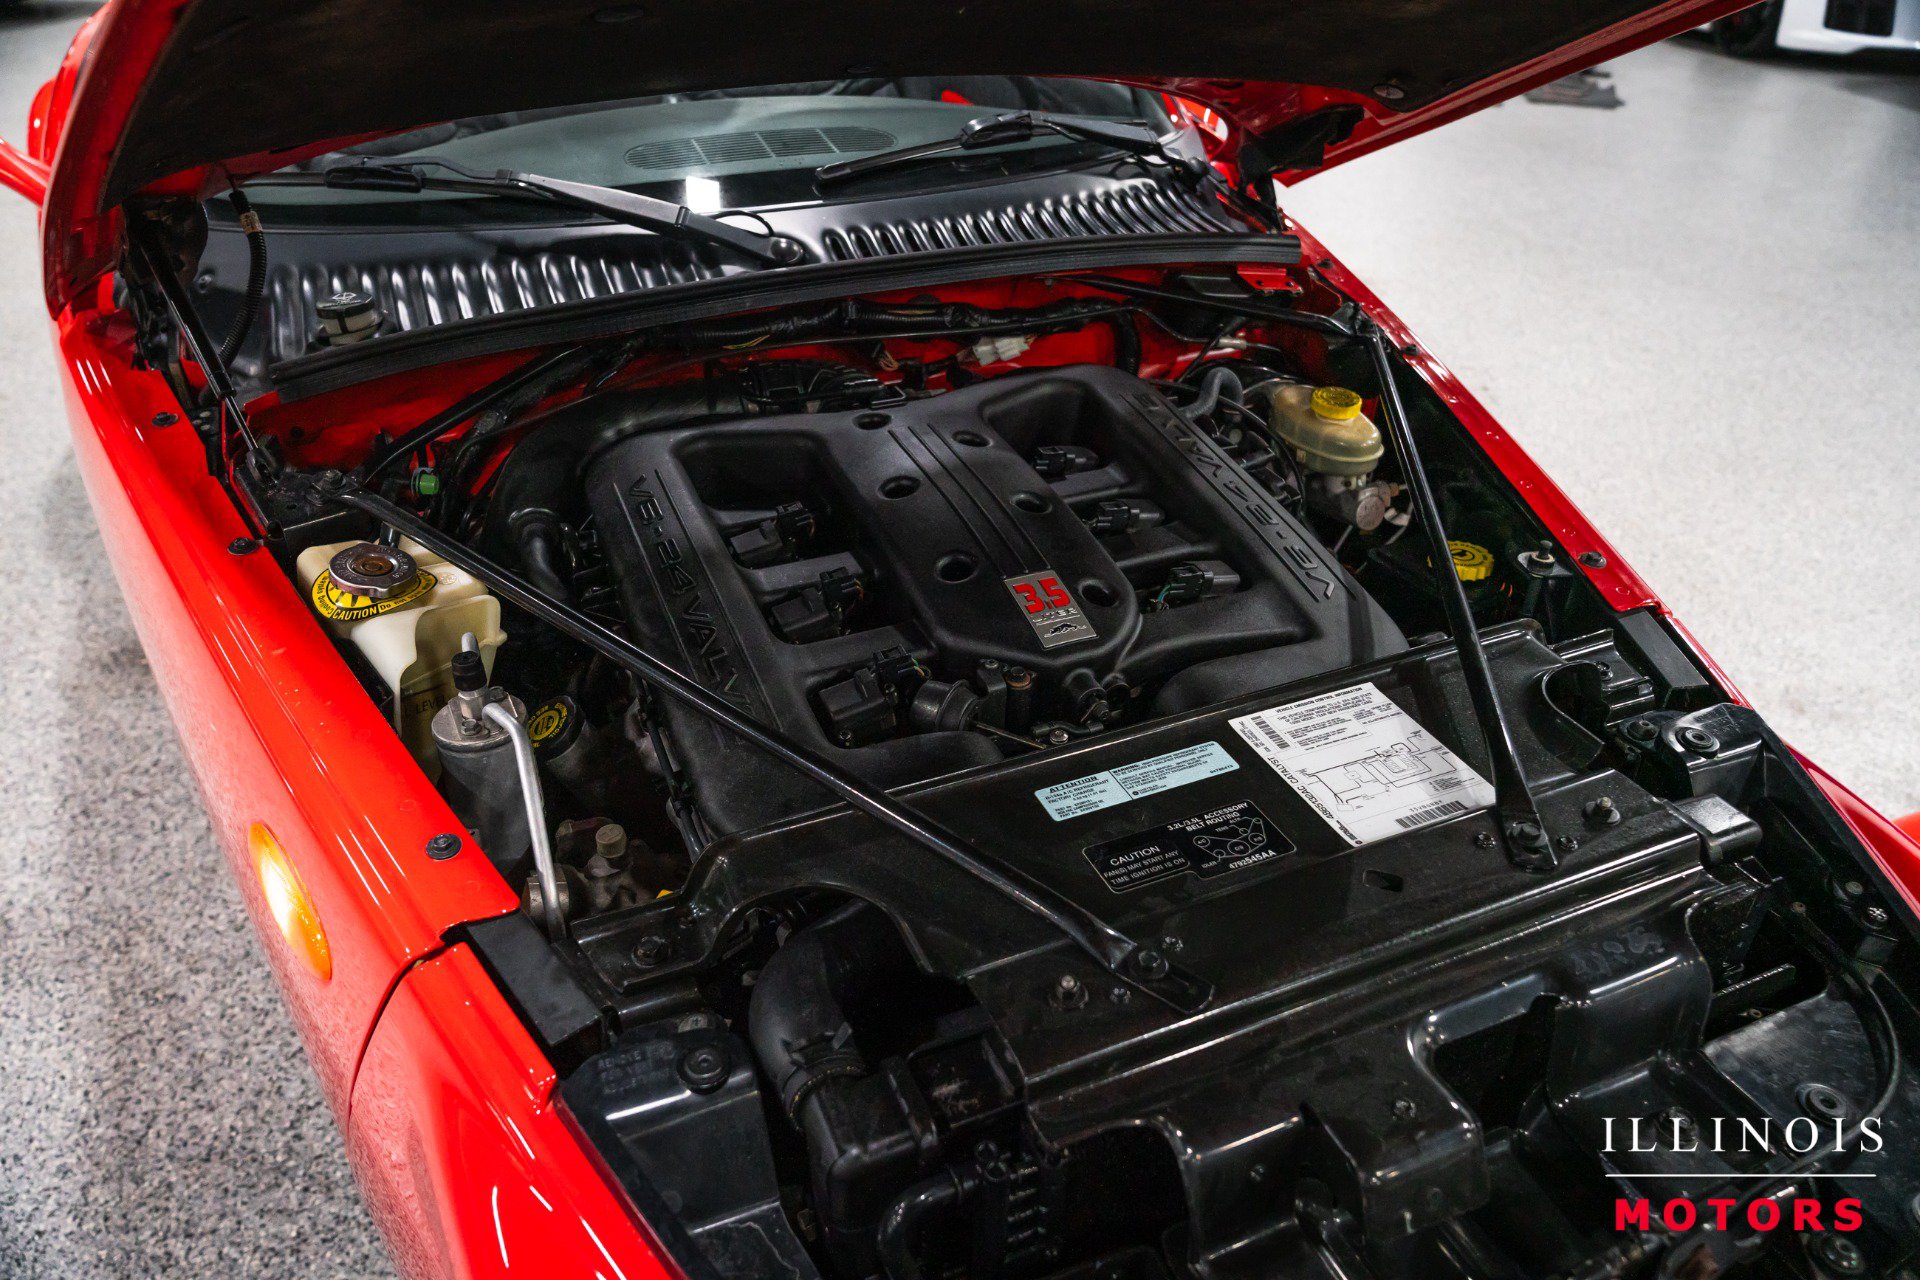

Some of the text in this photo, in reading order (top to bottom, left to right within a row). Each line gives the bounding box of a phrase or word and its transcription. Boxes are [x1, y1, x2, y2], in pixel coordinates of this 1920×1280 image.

[1013, 577, 1071, 614] 3.5
[332, 605, 377, 621] CAUTION
[1293, 700, 1315, 708] EMISSION
[1314, 695, 1334, 703] CONTROL
[1333, 687, 1363, 697] INFORMATION
[1267, 756, 1299, 784] CATALYST
[1049, 776, 1099, 793] ATTENTION
[1166, 802, 1248, 831] 3.2L/3.5L ACCESSORY
[1185, 811, 1240, 832] BELT ROUTING
[1110, 846, 1160, 866] CAUTION
[1127, 860, 1142, 871] MAY
[1142, 855, 1164, 866] START
[1165, 850, 1179, 860] ANY
[1229, 849, 1277, 869] 4792545AA
[1111, 875, 1131, 885] TIME
[1130, 864, 1165, 880] IGNITION
